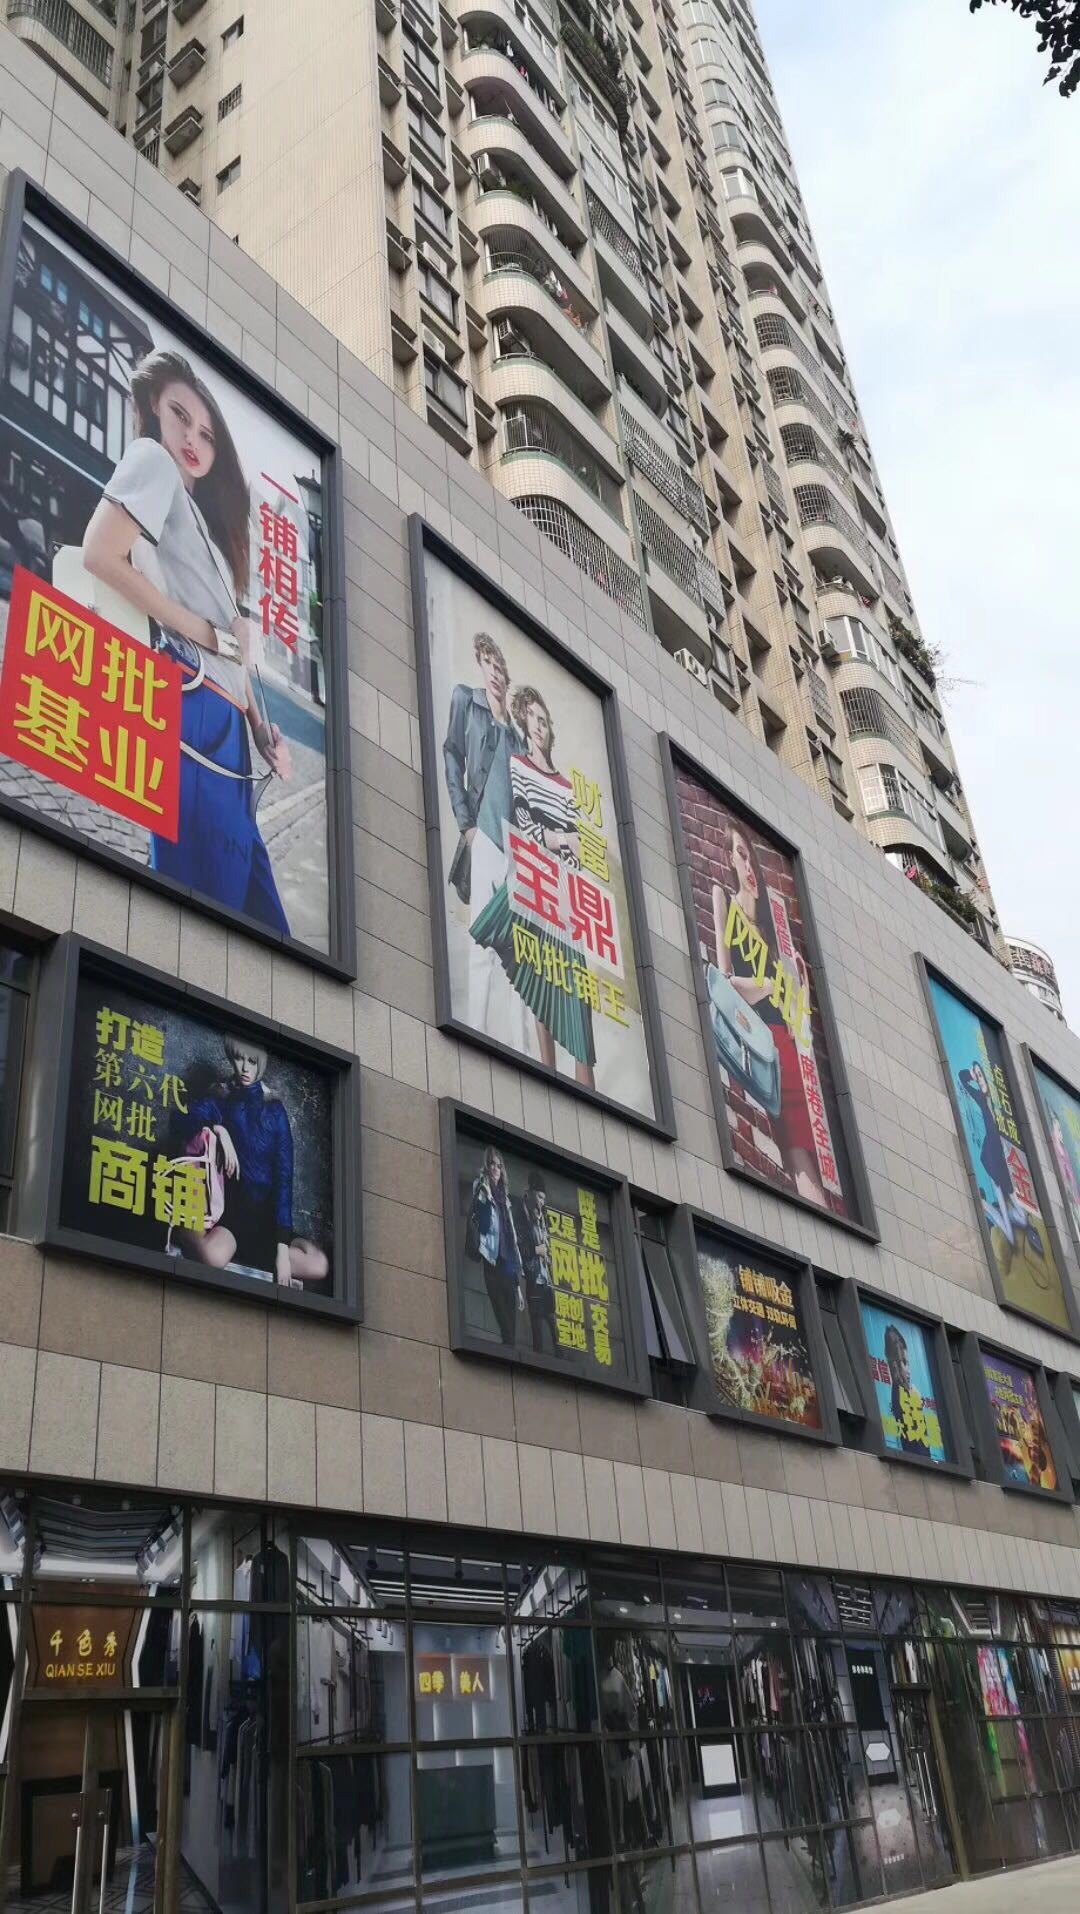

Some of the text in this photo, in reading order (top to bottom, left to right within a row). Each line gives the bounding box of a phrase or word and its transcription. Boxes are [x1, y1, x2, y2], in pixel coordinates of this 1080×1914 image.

[259, 471, 300, 655] 一铺相传
[24, 590, 169, 731] 网批
[13, 674, 165, 815] 基业
[570, 767, 610, 883] 财富
[508, 831, 618, 966] 宝鼎
[512, 922, 631, 1029] 网批铺王
[724, 898, 812, 1048] 网批
[92, 1047, 189, 1115] 第六代
[95, 1006, 165, 1067] 打造
[93, 1088, 157, 1143] 网批
[88, 1135, 208, 1233] 商铺
[549, 1237, 609, 1302] 网批
[49, 1629, 118, 1657] 千色秀
